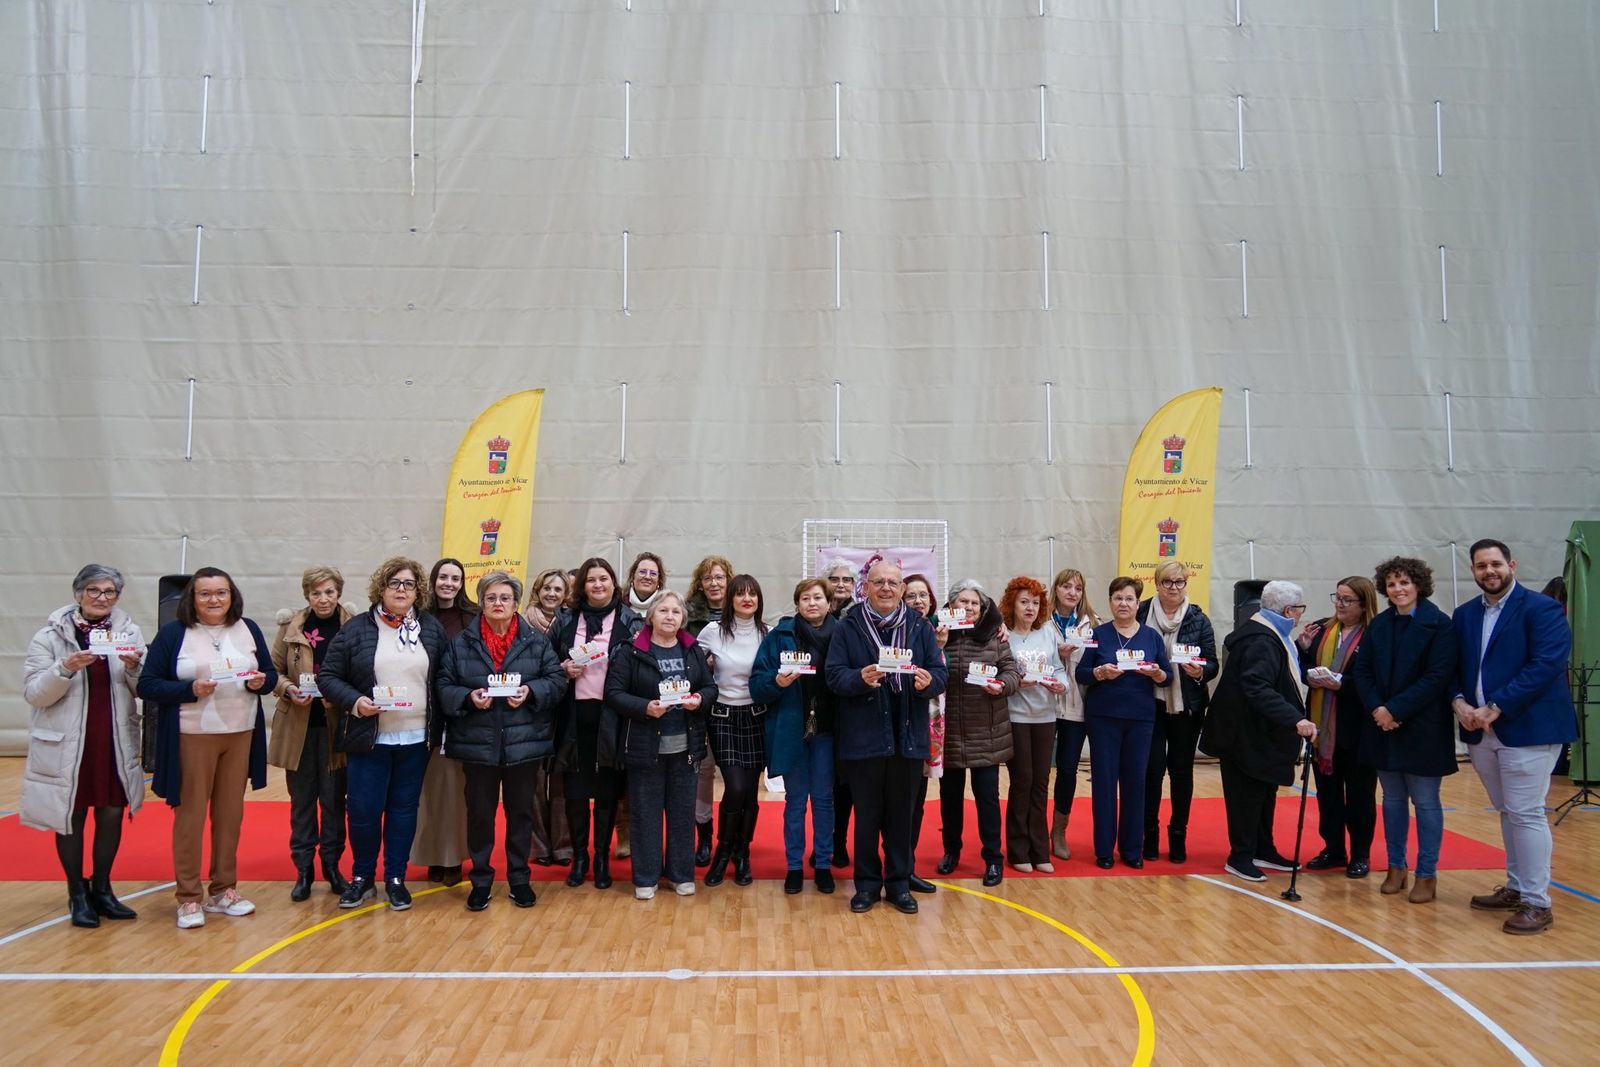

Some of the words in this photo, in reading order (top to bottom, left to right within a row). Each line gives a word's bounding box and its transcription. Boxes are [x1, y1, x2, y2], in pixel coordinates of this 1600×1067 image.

[458, 478, 503, 487] Ayuntamiento
[1134, 478, 1181, 486] Ayuntamiento
[1165, 488, 1176, 496] del
